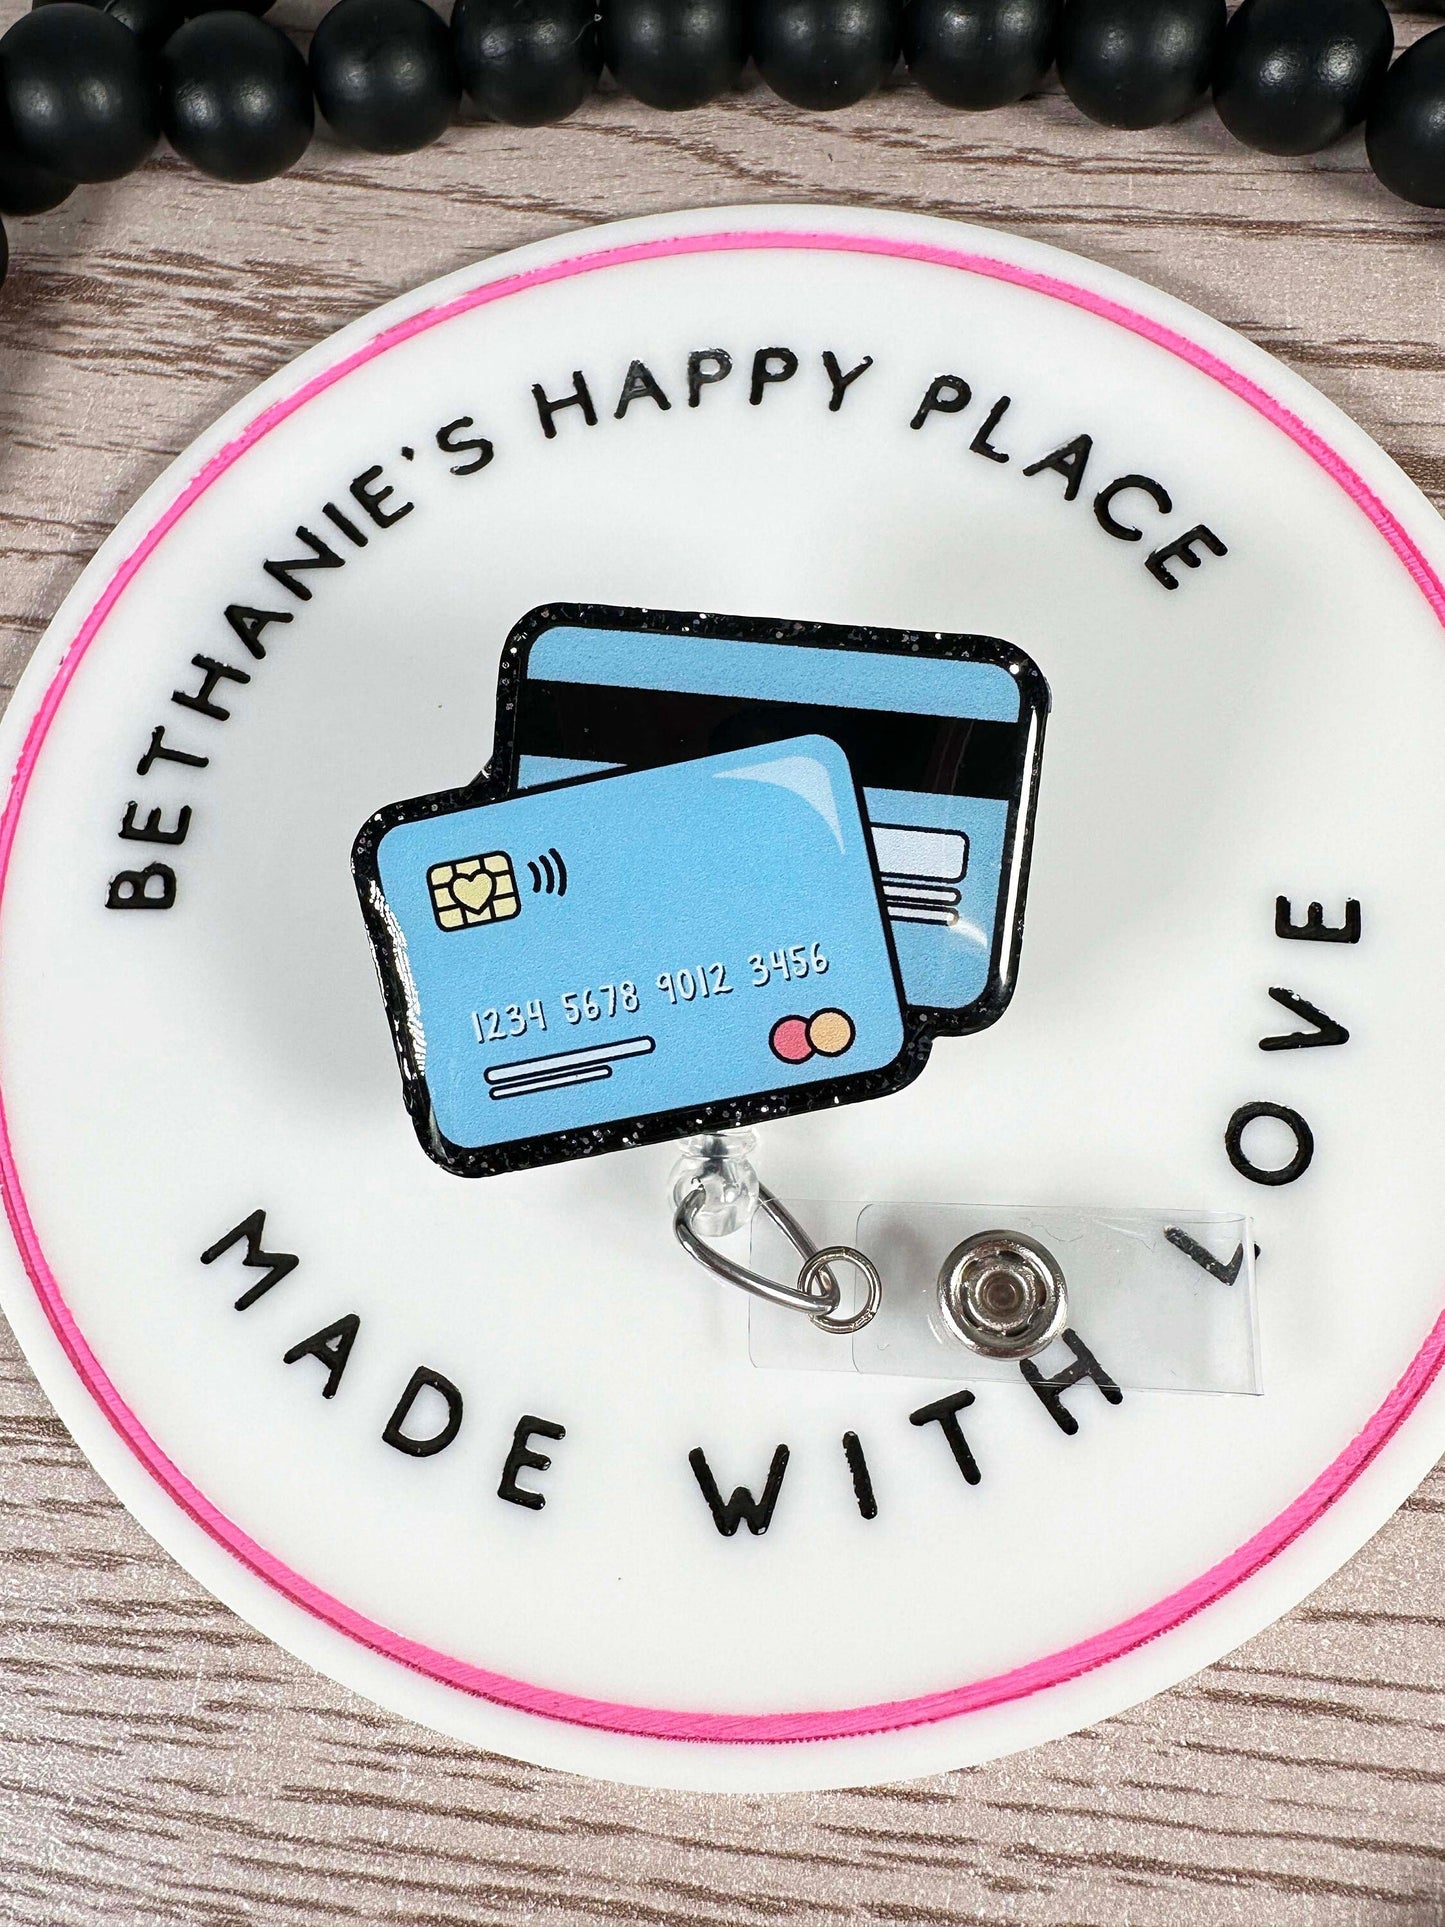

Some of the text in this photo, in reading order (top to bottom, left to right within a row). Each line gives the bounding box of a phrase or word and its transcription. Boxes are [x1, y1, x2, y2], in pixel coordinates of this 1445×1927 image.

[103, 346, 1230, 911] BETHANIE'S HAPPY PLACE
[199, 893, 1363, 1538] MADE WITH LOVE
[471, 941, 831, 1045] 1234 5678 9012 3456
